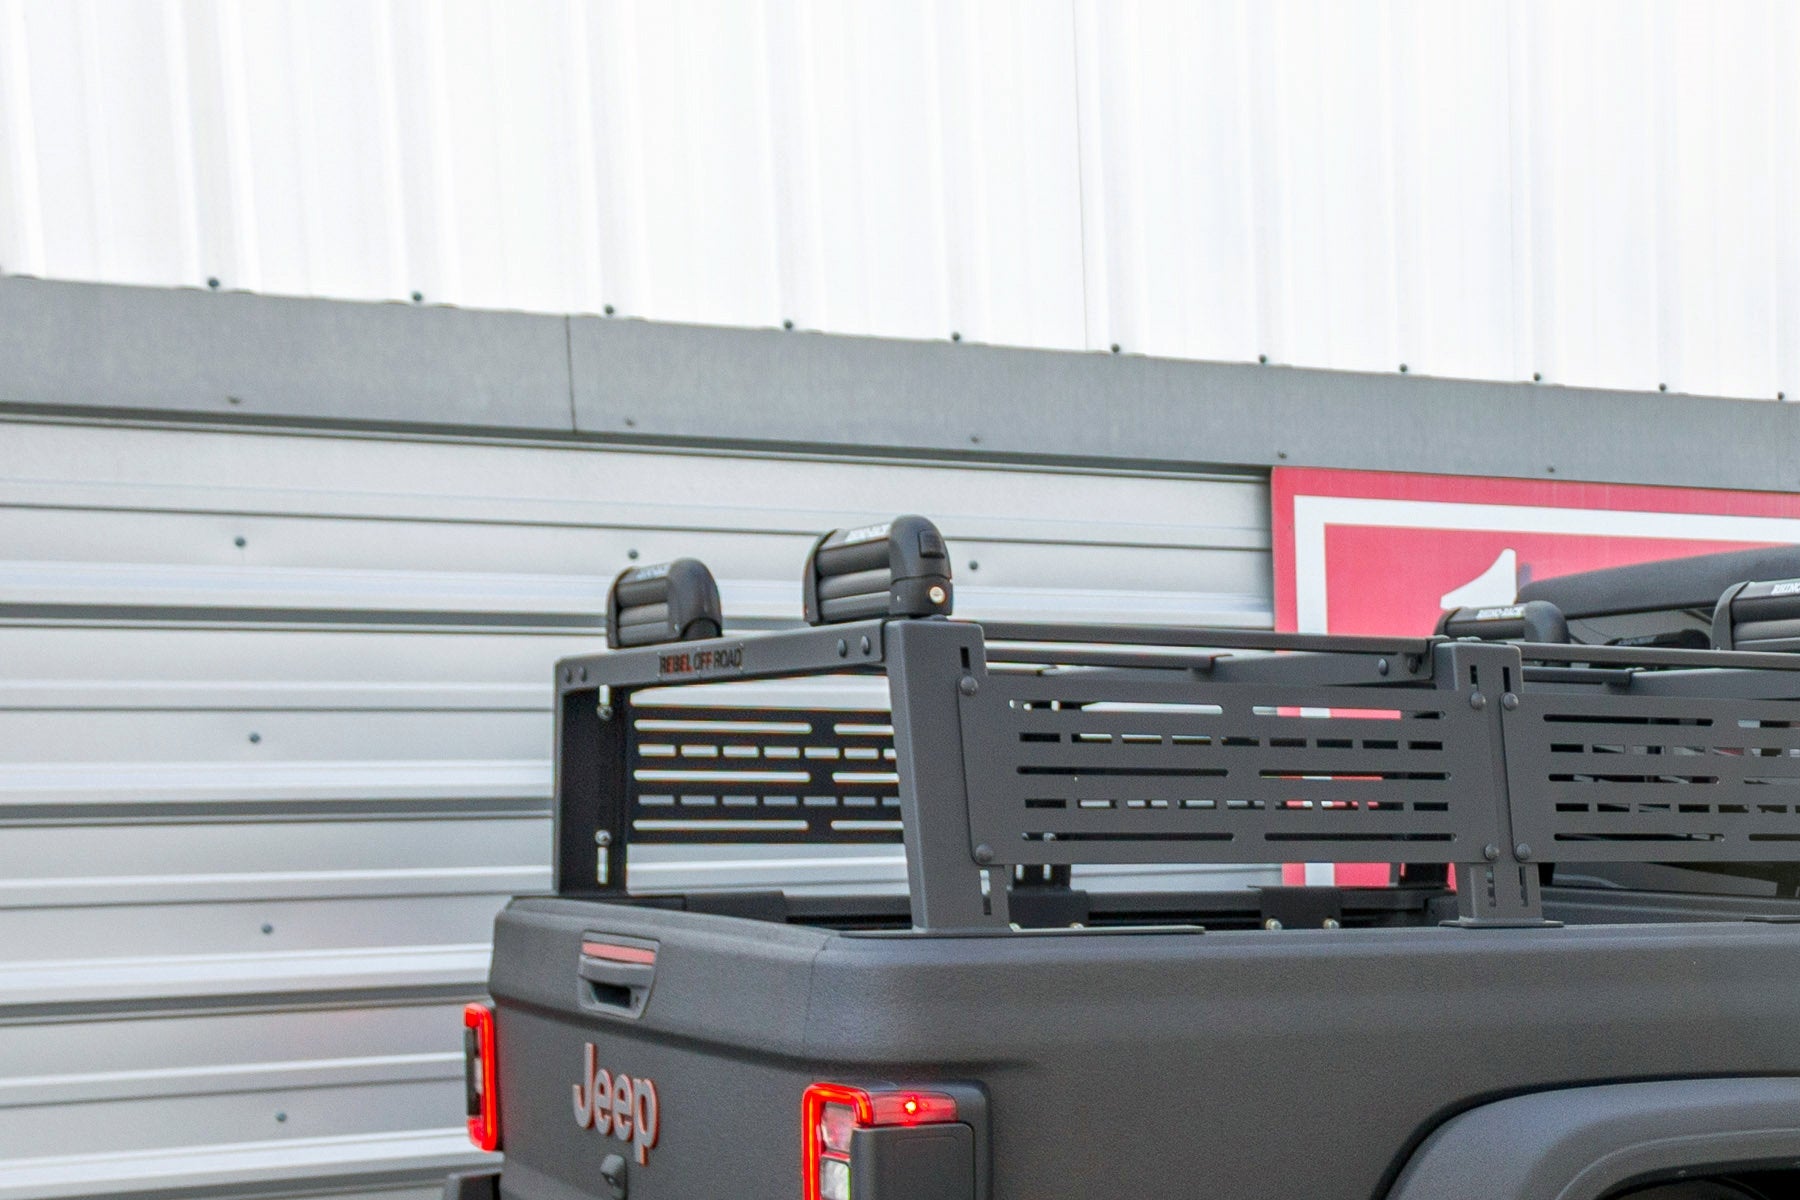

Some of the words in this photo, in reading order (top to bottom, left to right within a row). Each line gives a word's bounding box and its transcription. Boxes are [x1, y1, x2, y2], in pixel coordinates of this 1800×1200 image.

[659, 653, 694, 674] REBEL
[693, 651, 713, 670] OFF
[713, 647, 743, 668] ROAD
[572, 1042, 660, 1166] Jeep
